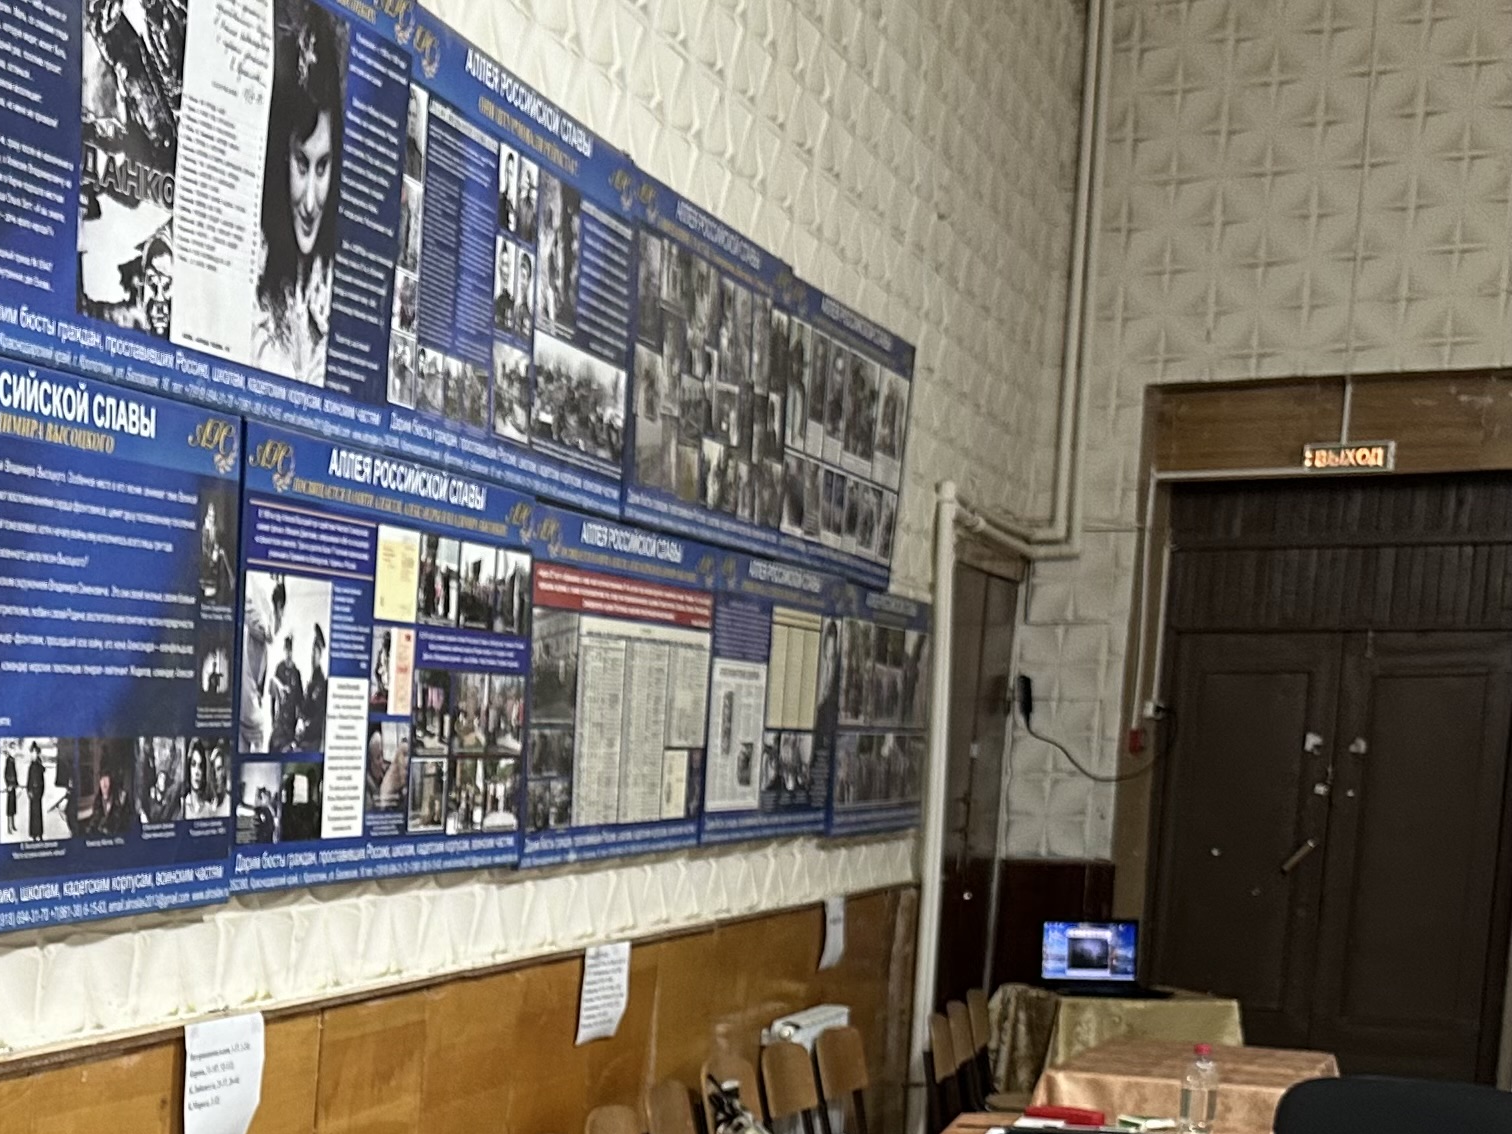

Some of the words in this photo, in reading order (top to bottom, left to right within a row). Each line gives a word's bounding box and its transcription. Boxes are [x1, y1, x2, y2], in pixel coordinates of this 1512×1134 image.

[81, 141, 176, 212] ДАНКО
[44, 423, 116, 454] ВЫСОЦКОГО
[93, 393, 157, 439] СЛАВЫ
[328, 448, 372, 484] АЛЛЕЯ
[372, 459, 448, 502] РОССИЙСКОЙ
[449, 479, 487, 511] СЛАВЫ
